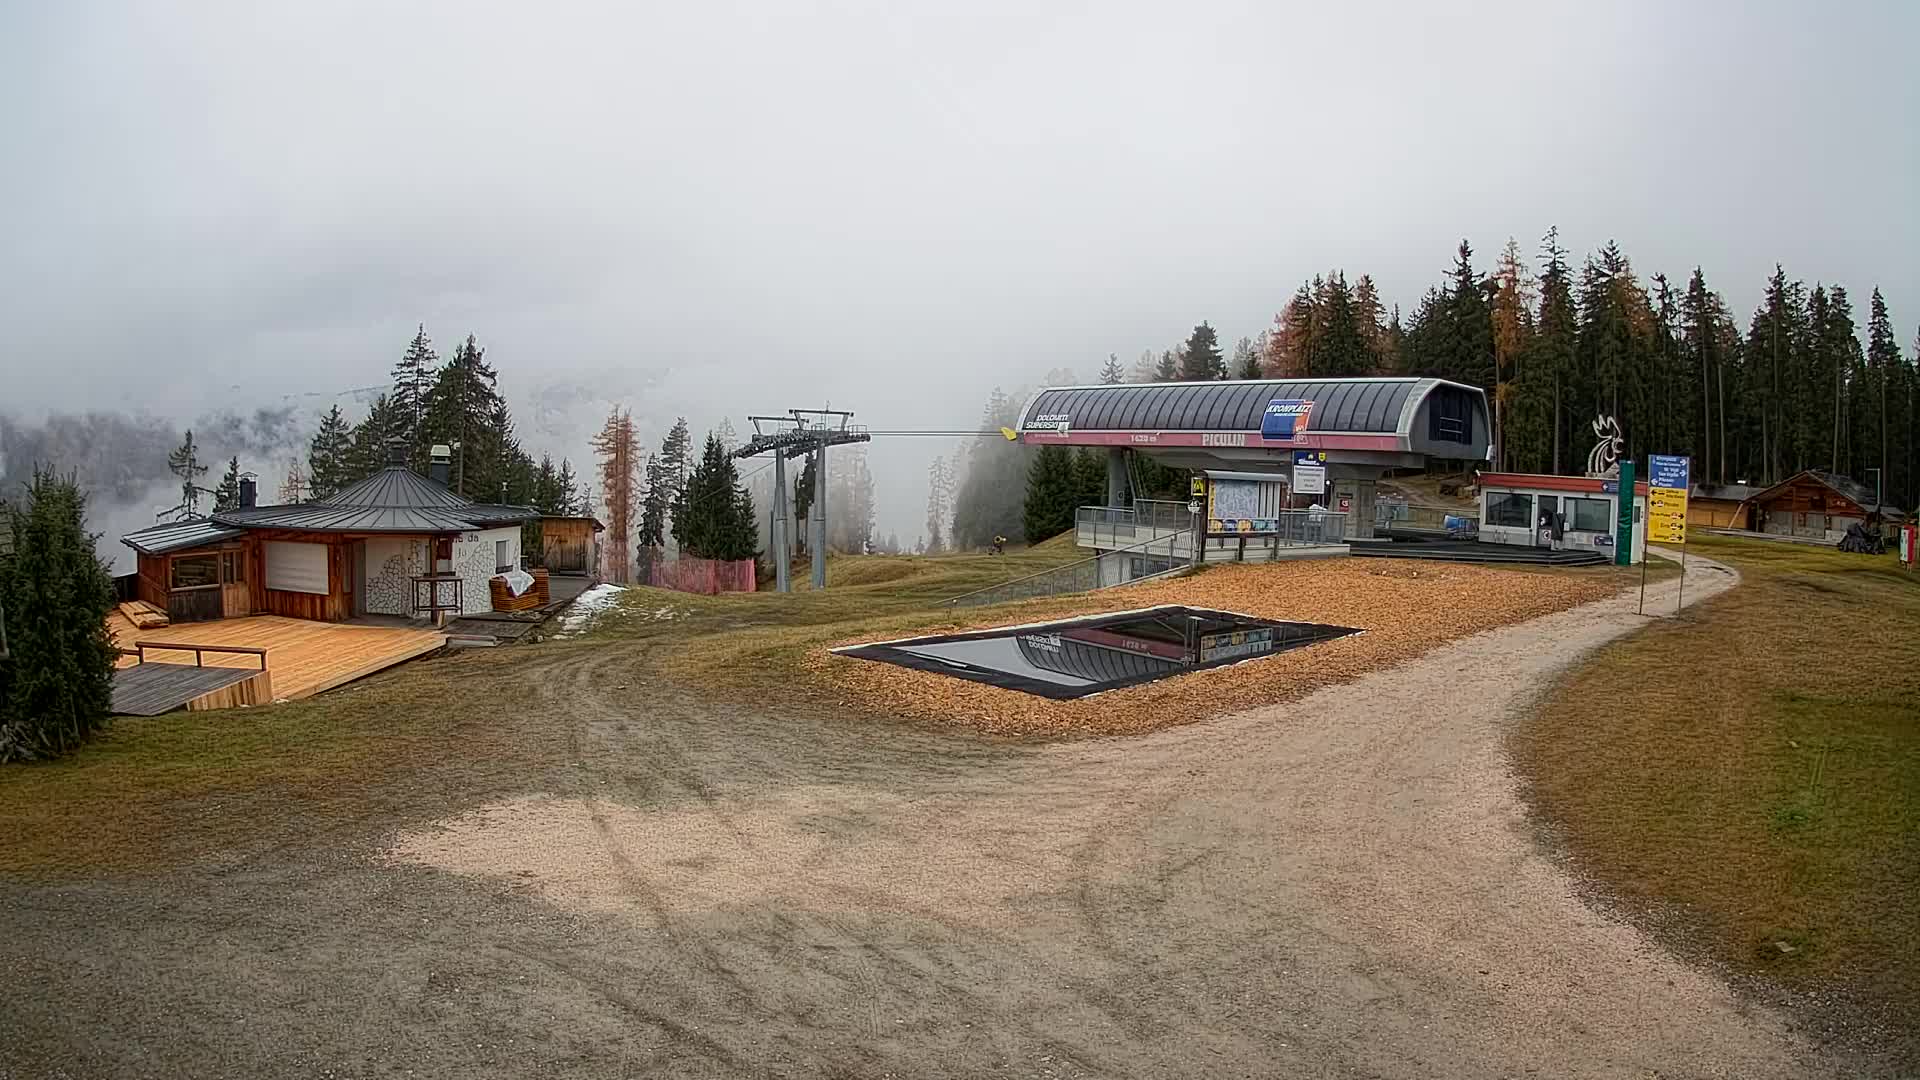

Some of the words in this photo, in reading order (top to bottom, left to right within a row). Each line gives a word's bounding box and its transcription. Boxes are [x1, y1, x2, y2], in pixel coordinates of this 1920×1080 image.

[1265, 404, 1312, 413] KRONPLATZ
[1025, 421, 1059, 429] SUPERSKI
[1202, 433, 1245, 446] PICULIN
[467, 533, 479, 543] da
